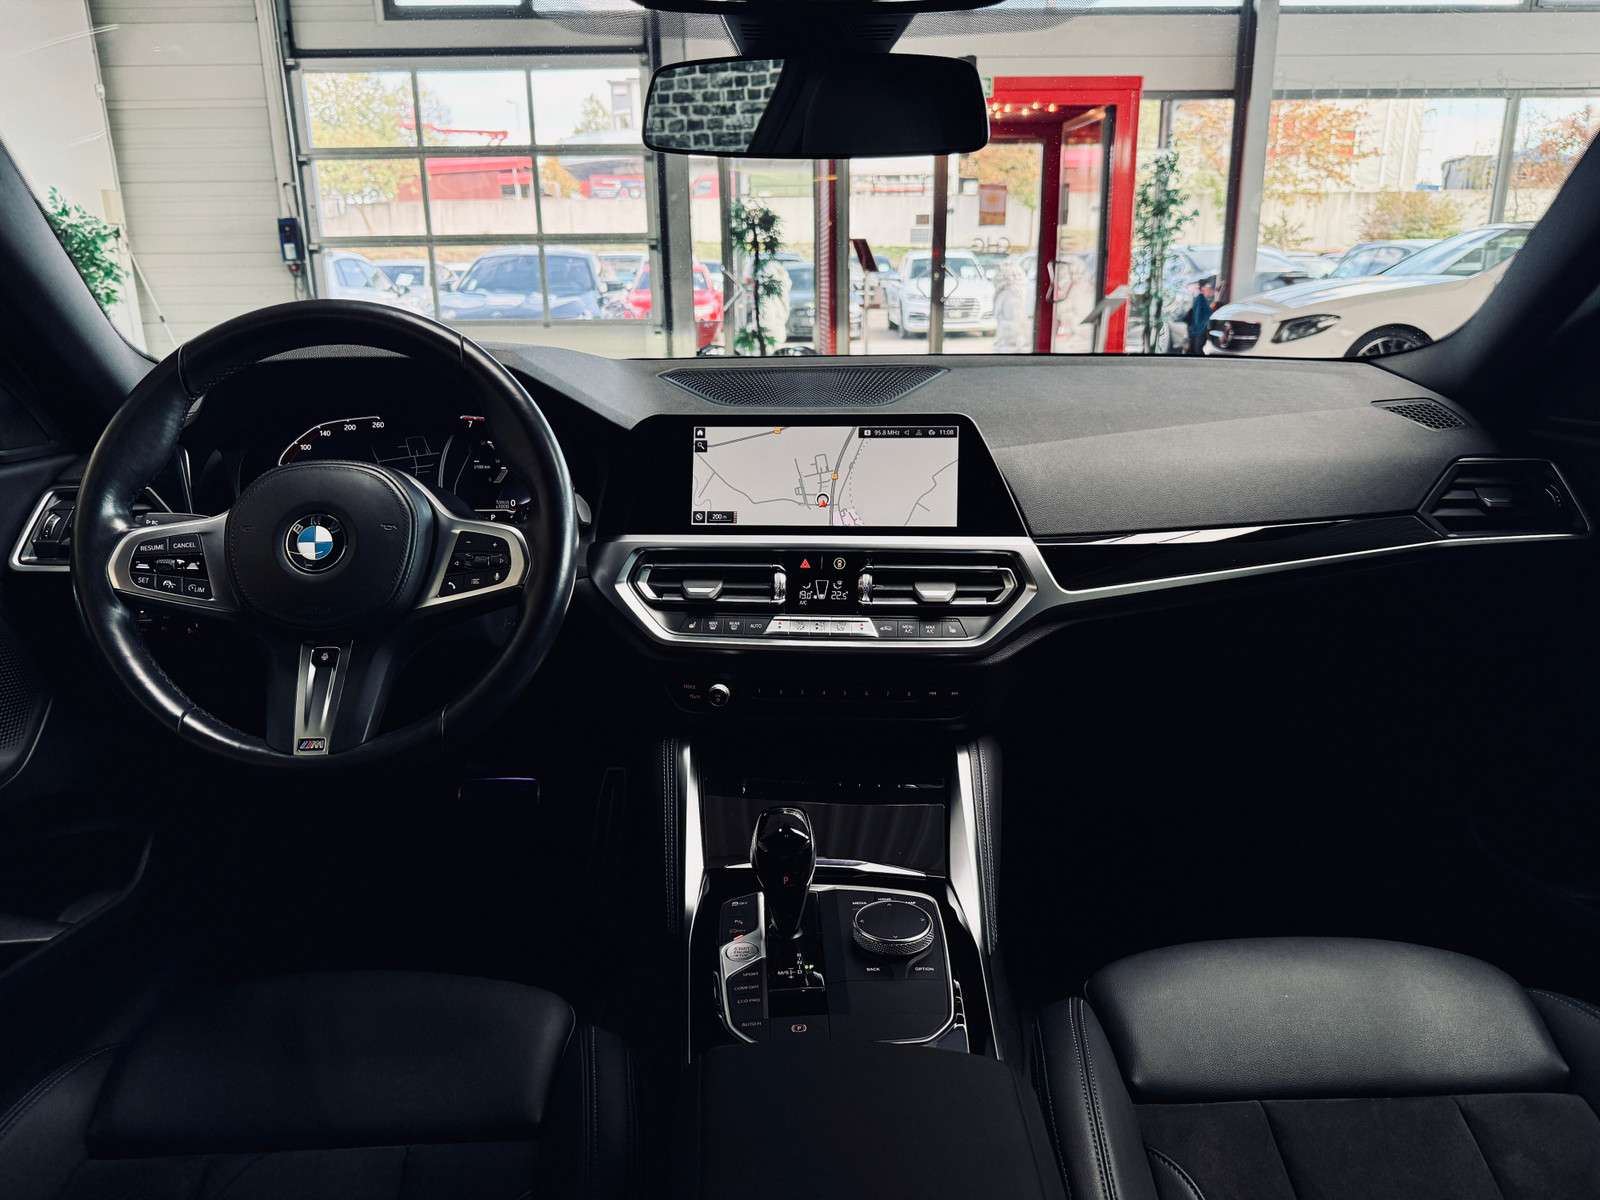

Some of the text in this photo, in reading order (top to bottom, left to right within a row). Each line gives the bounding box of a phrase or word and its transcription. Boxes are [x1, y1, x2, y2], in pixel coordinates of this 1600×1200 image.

[372, 421, 385, 429] 260
[510, 499, 516, 507] 0
[140, 544, 165, 552] RESUME
